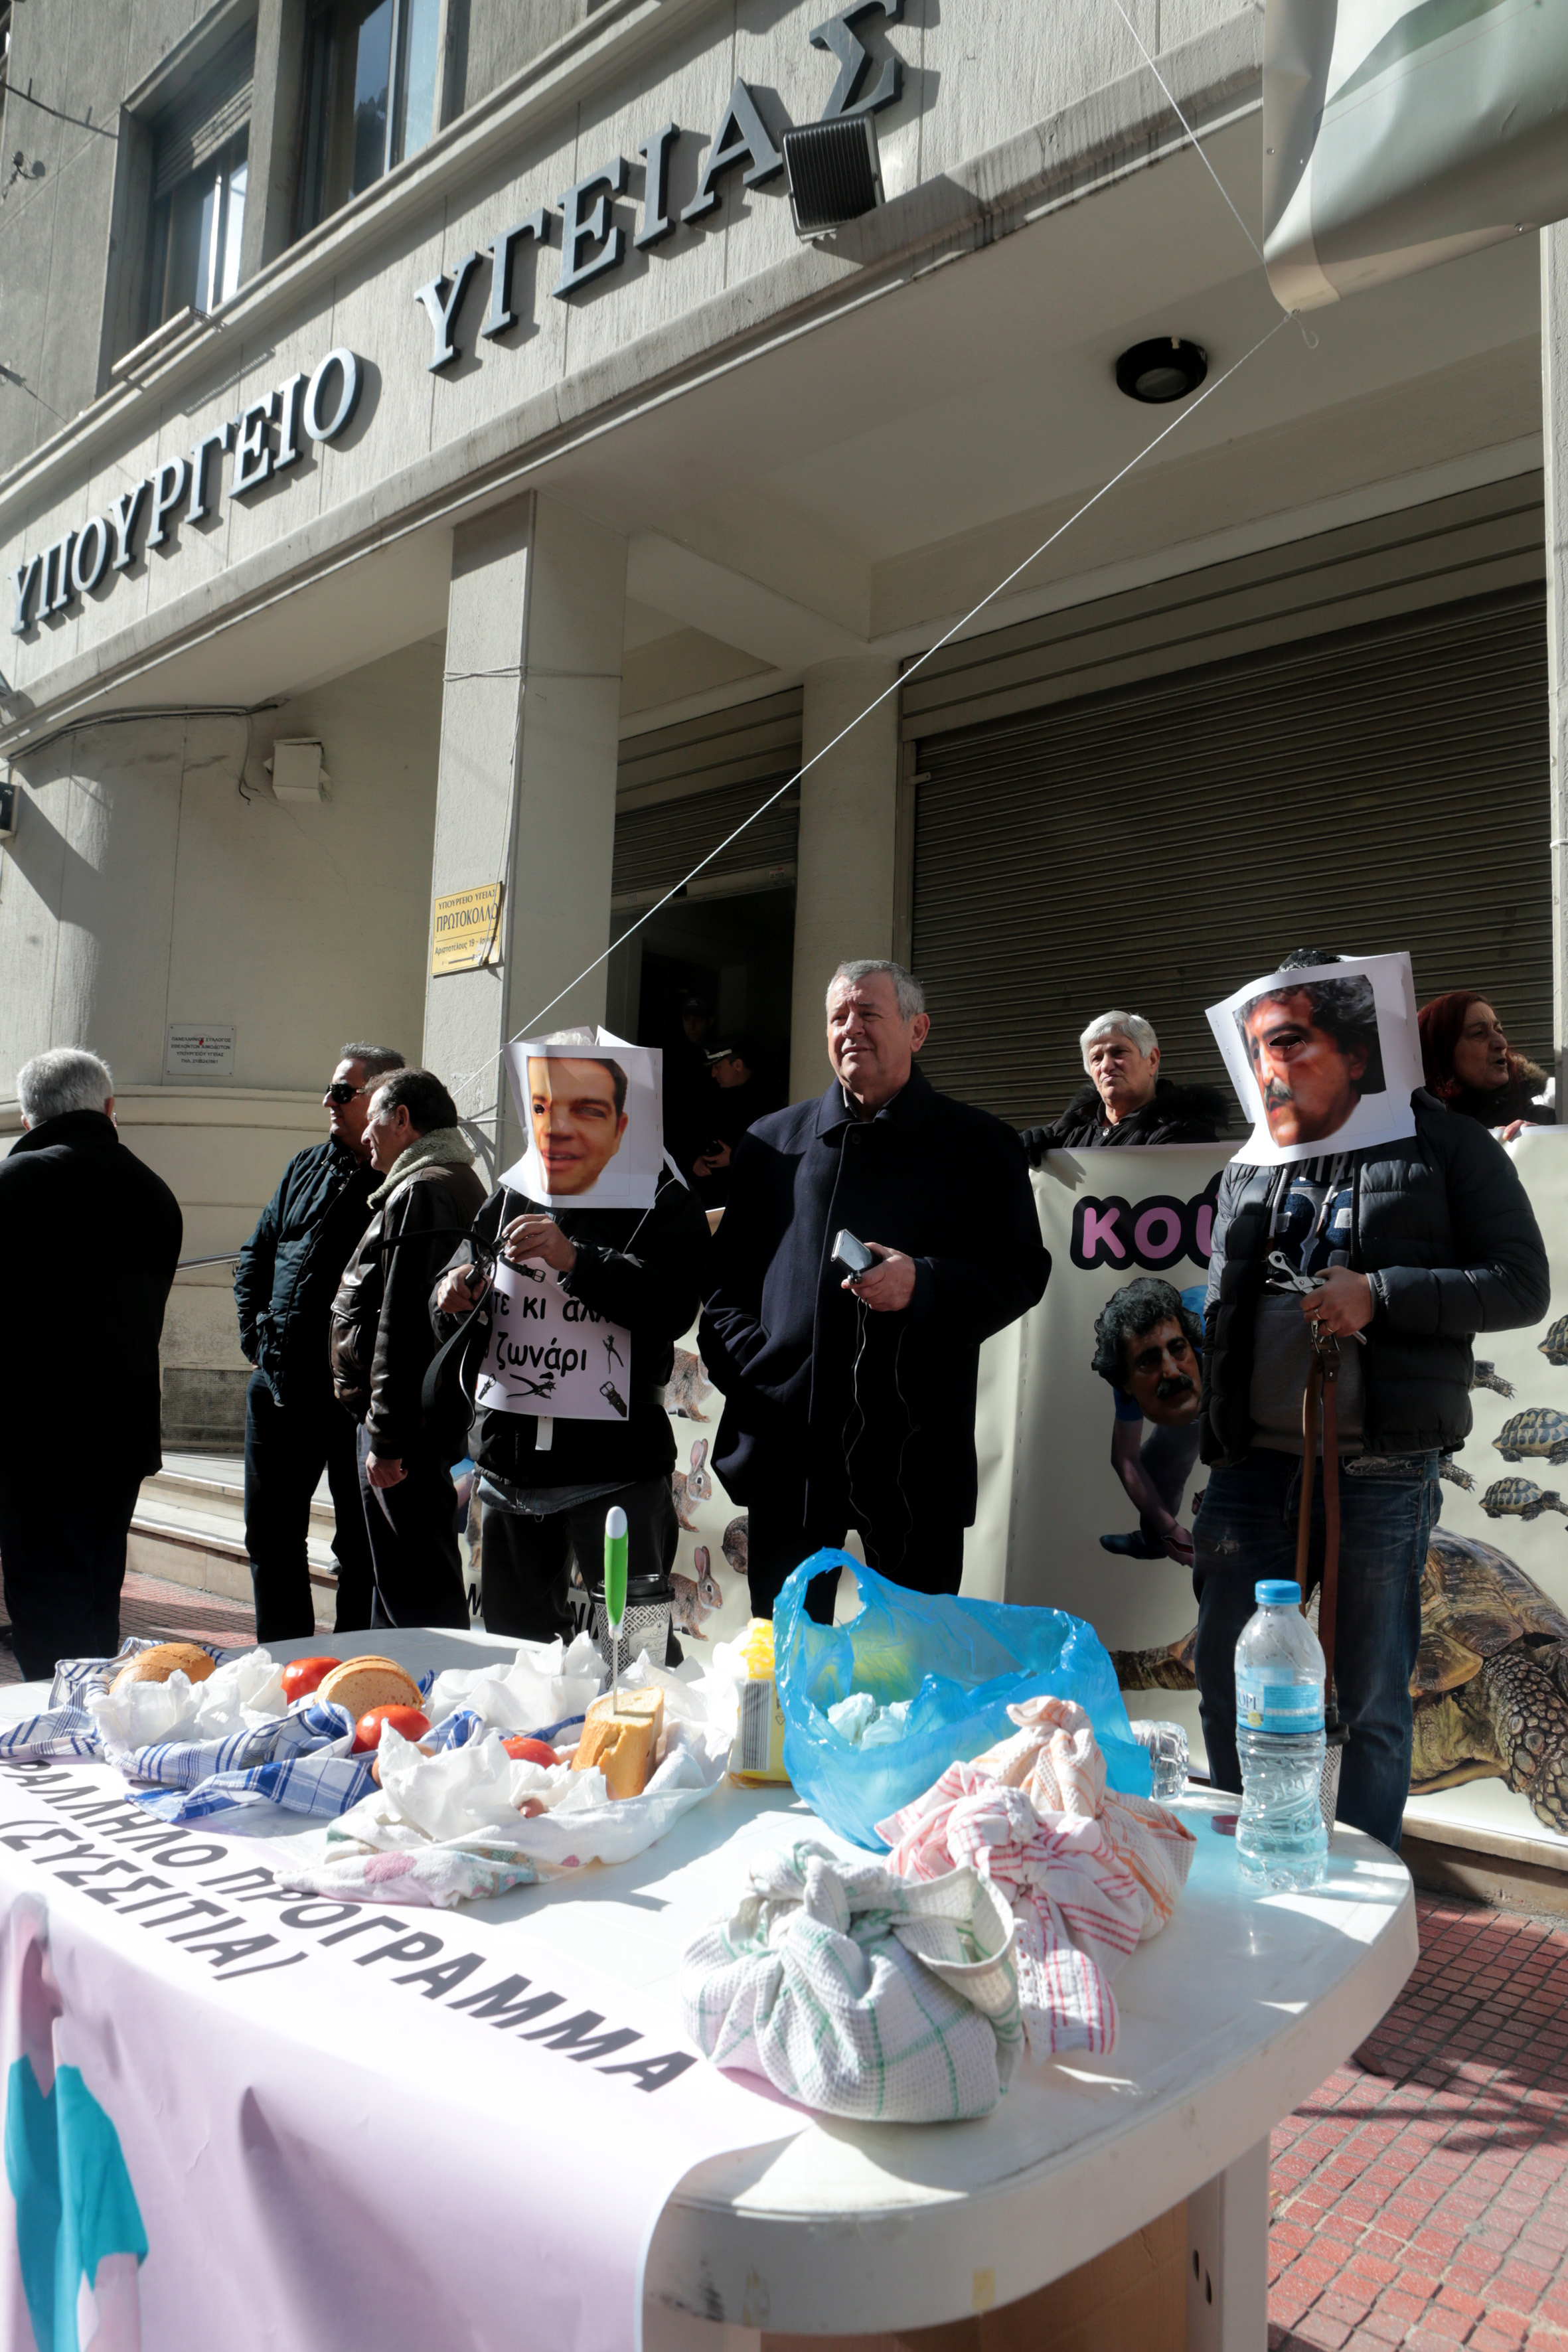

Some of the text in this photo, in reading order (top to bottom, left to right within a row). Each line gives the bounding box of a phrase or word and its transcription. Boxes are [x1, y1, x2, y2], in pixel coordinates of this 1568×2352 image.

[8, 0, 903, 635] ΥΠΟΥΡΓΕΙΟ ΥΓΕΙΑΣ
[436, 903, 498, 932] ΠΡΩΤΟΚΟΛΛΟ
[439, 890, 496, 909] ΥΠΟΥΡΓΕΙΟ ΥΓΕΙΑΣ
[435, 942, 467, 956] Αριστοτέλους
[497, 1331, 587, 1377] ζωνάρι
[0, 1820, 309, 1981] (ΣΥΣΣΙΤΙΑ)
[0, 1759, 699, 2092] ΡΑΛΛΗΛΟ ΠΡΟΓΡΑΜΜΑ
